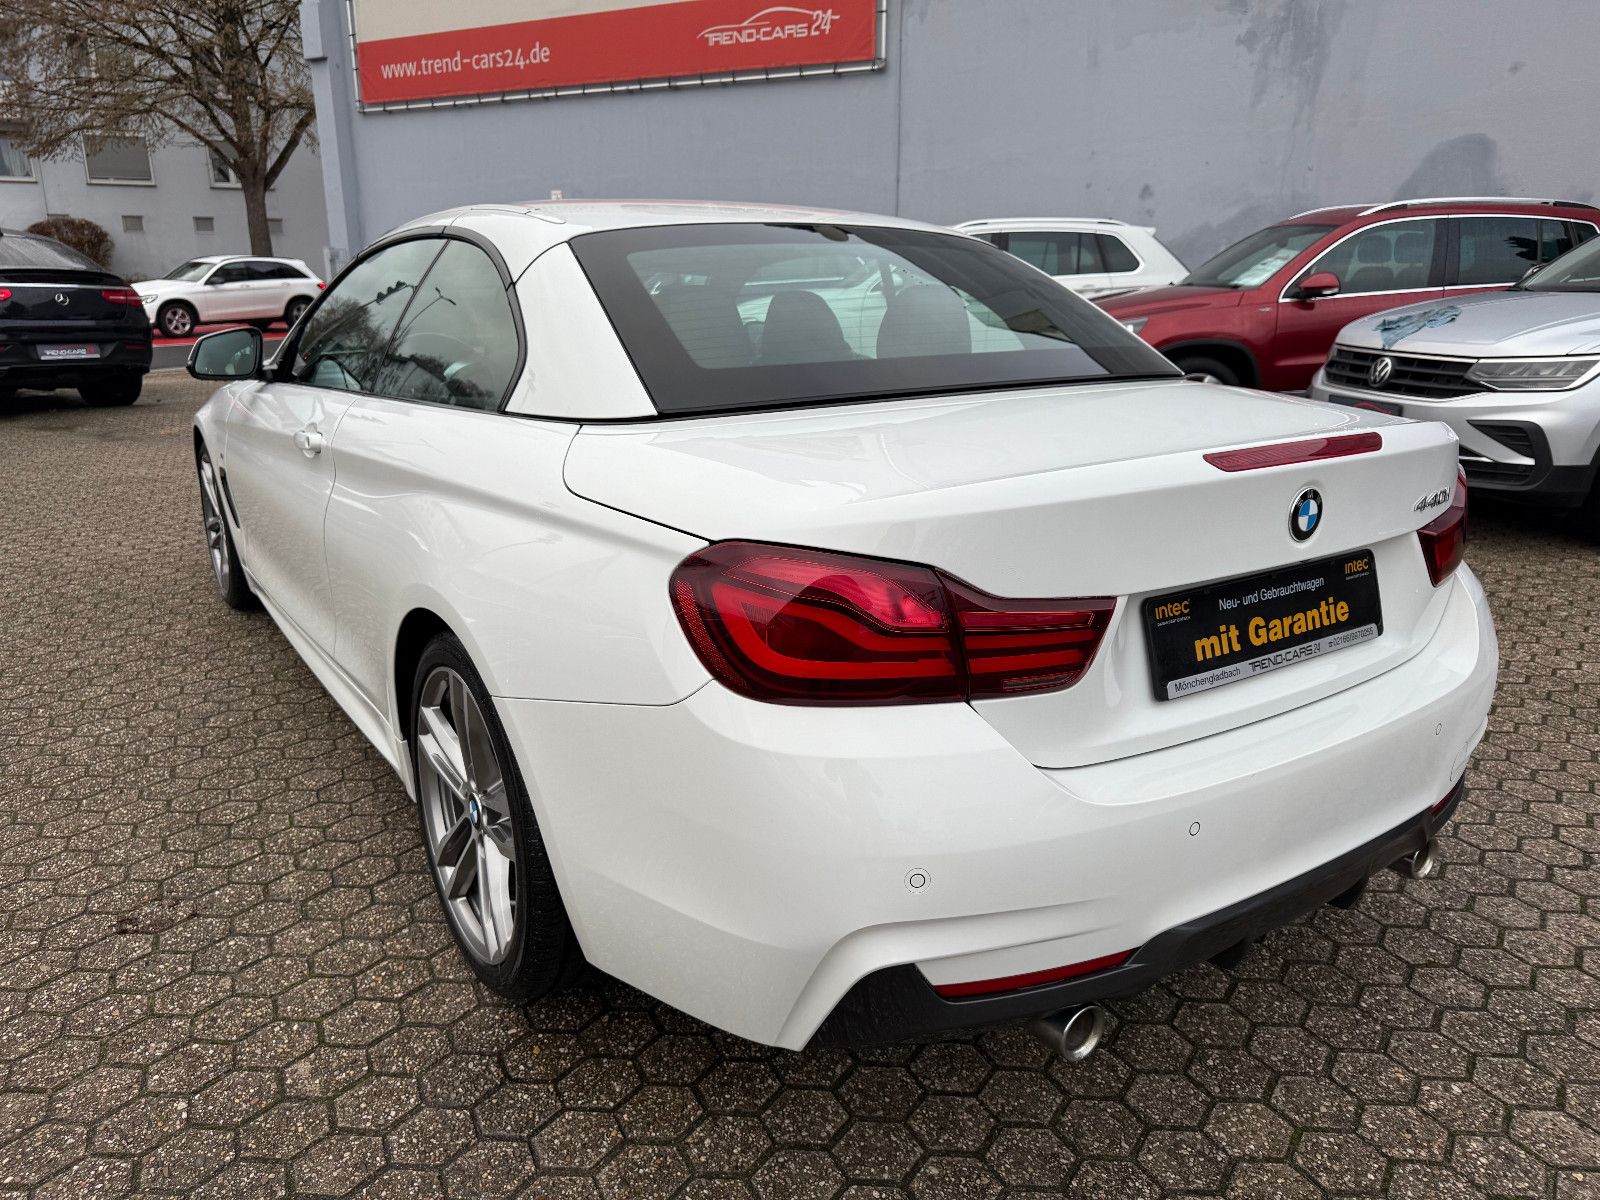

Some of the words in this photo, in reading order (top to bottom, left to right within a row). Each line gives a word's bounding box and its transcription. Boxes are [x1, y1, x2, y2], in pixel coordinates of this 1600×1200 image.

[704, 23, 809, 46] TREND-CARS
[810, 9, 833, 36] 24
[381, 41, 551, 79] www.trend-cars24.de
[1219, 598, 1241, 611] Neu-
[1243, 591, 1259, 605] und
[1260, 577, 1325, 601] Gebrauchtwagen
[1195, 625, 1242, 662] mit
[1249, 597, 1350, 647] Garantie
[1174, 667, 1241, 692] Mönchengladbach
[1249, 645, 1314, 672] TREND-CARS
